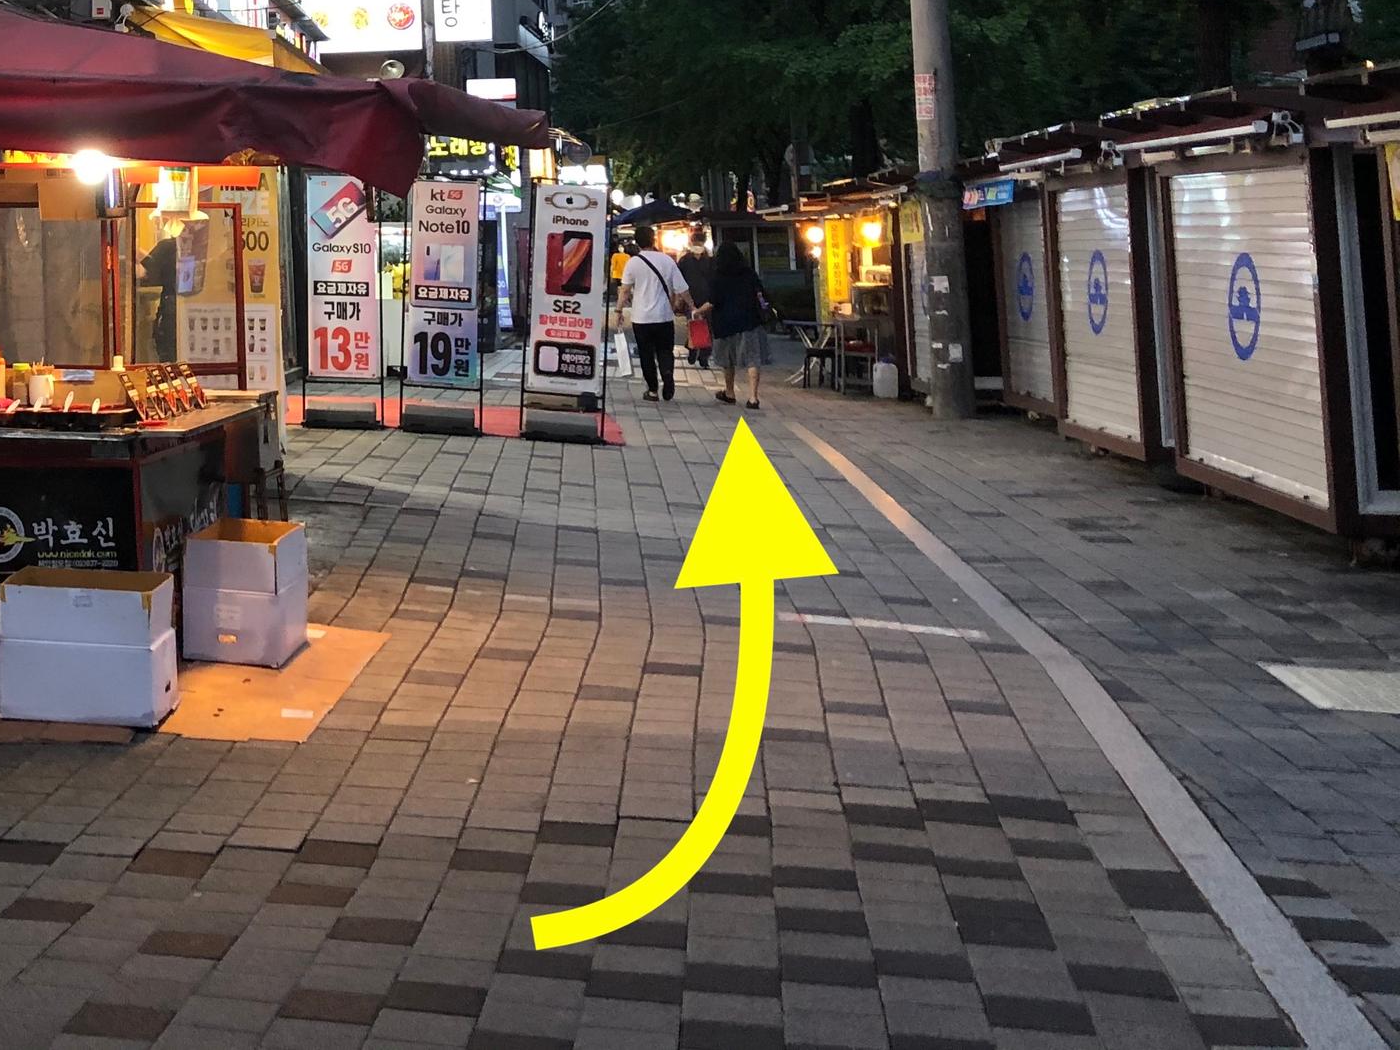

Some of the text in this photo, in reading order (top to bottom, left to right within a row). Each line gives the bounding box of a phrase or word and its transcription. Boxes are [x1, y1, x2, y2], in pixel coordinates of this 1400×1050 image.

[428, 136, 488, 157] 노래방
[429, 188, 446, 201] kt
[325, 197, 359, 230] 5G
[425, 204, 467, 218] Galaxy
[552, 214, 589, 227] iPhone
[333, 261, 350, 272] 5G
[316, 282, 368, 295] 요금제자유
[417, 287, 470, 300] 요금제자유
[323, 301, 361, 321] 구매가
[552, 299, 582, 315] SE2
[423, 310, 464, 327] 구매가
[313, 326, 352, 372] 13
[413, 331, 453, 377] 19
[32, 516, 116, 549] 박효신
